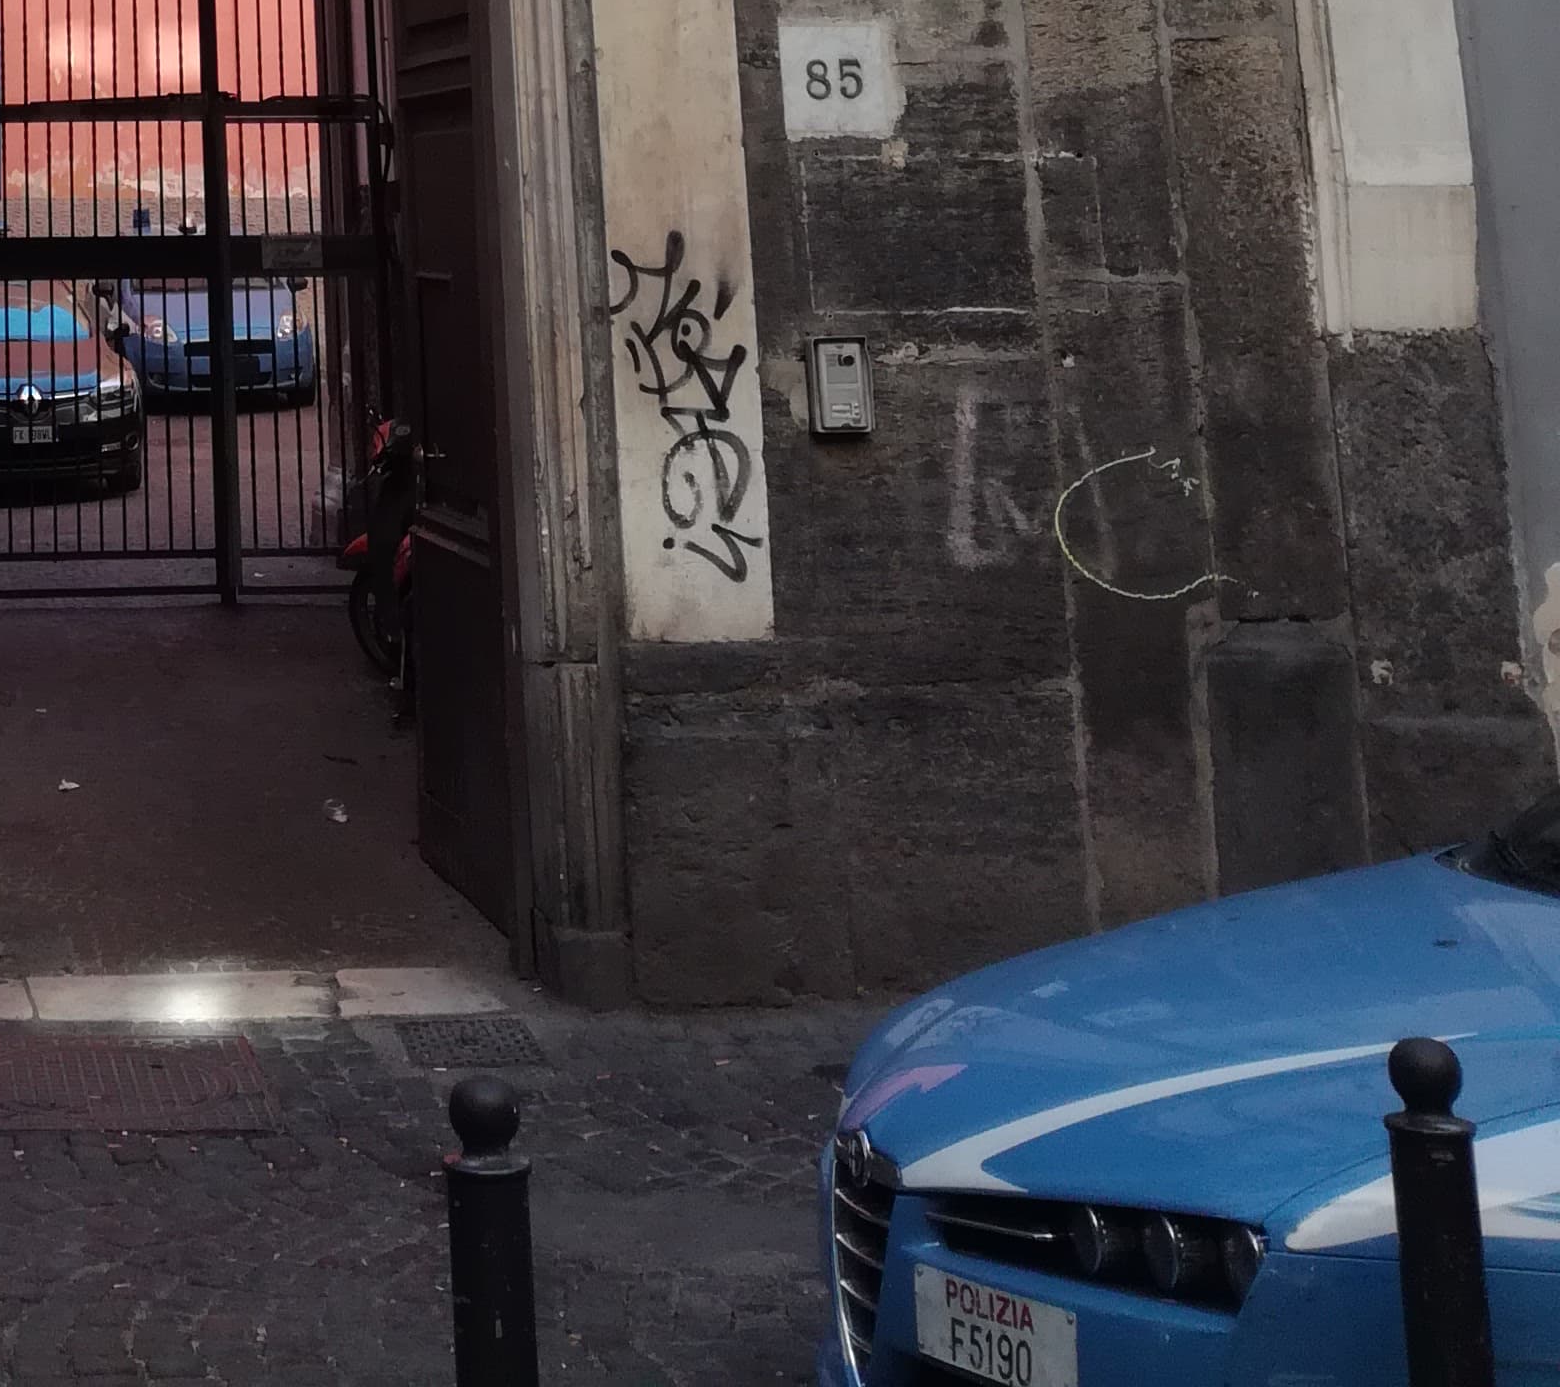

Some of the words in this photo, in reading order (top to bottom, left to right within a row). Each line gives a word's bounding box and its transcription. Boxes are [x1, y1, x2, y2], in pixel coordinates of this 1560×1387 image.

[805, 58, 863, 100] 85
[945, 1279, 1034, 1335] POLIZIA
[951, 1316, 1032, 1386] F5190
